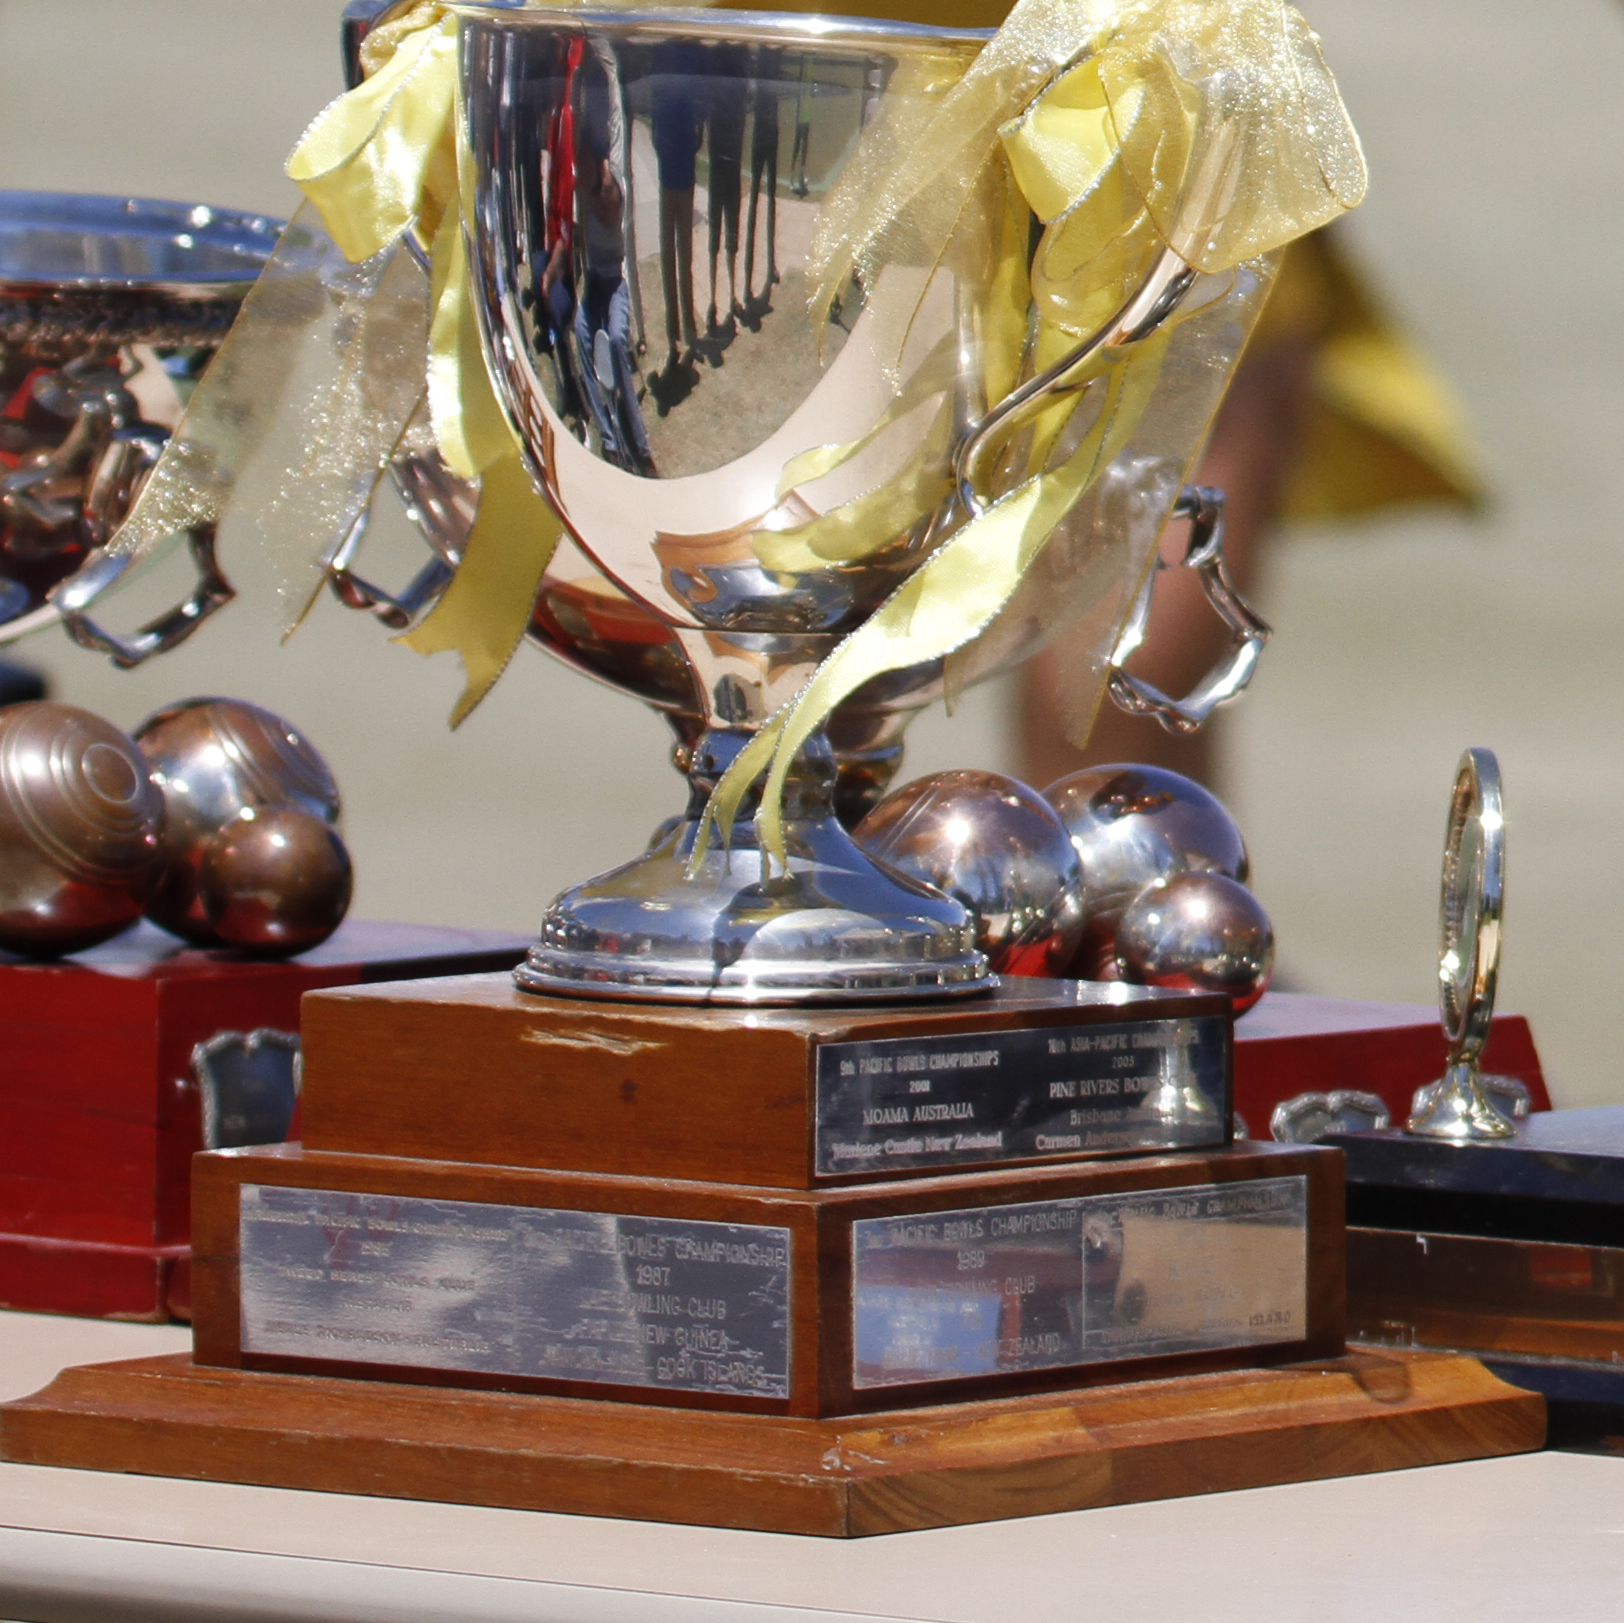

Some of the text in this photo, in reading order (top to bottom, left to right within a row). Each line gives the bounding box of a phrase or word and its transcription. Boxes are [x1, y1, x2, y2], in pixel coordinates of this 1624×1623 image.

[1050, 1082, 1076, 1098] PINE
[1080, 1078, 1119, 1096] RIVERS
[863, 1102, 974, 1125] MOAMA AUSTRALIA
[1035, 1134, 1081, 1150] Carmen
[991, 1210, 1078, 1236] CHAMPIONSHIP
[635, 1265, 672, 1287] 1987
[687, 1297, 727, 1320] CLUB
[674, 1325, 728, 1351] GUINEA
